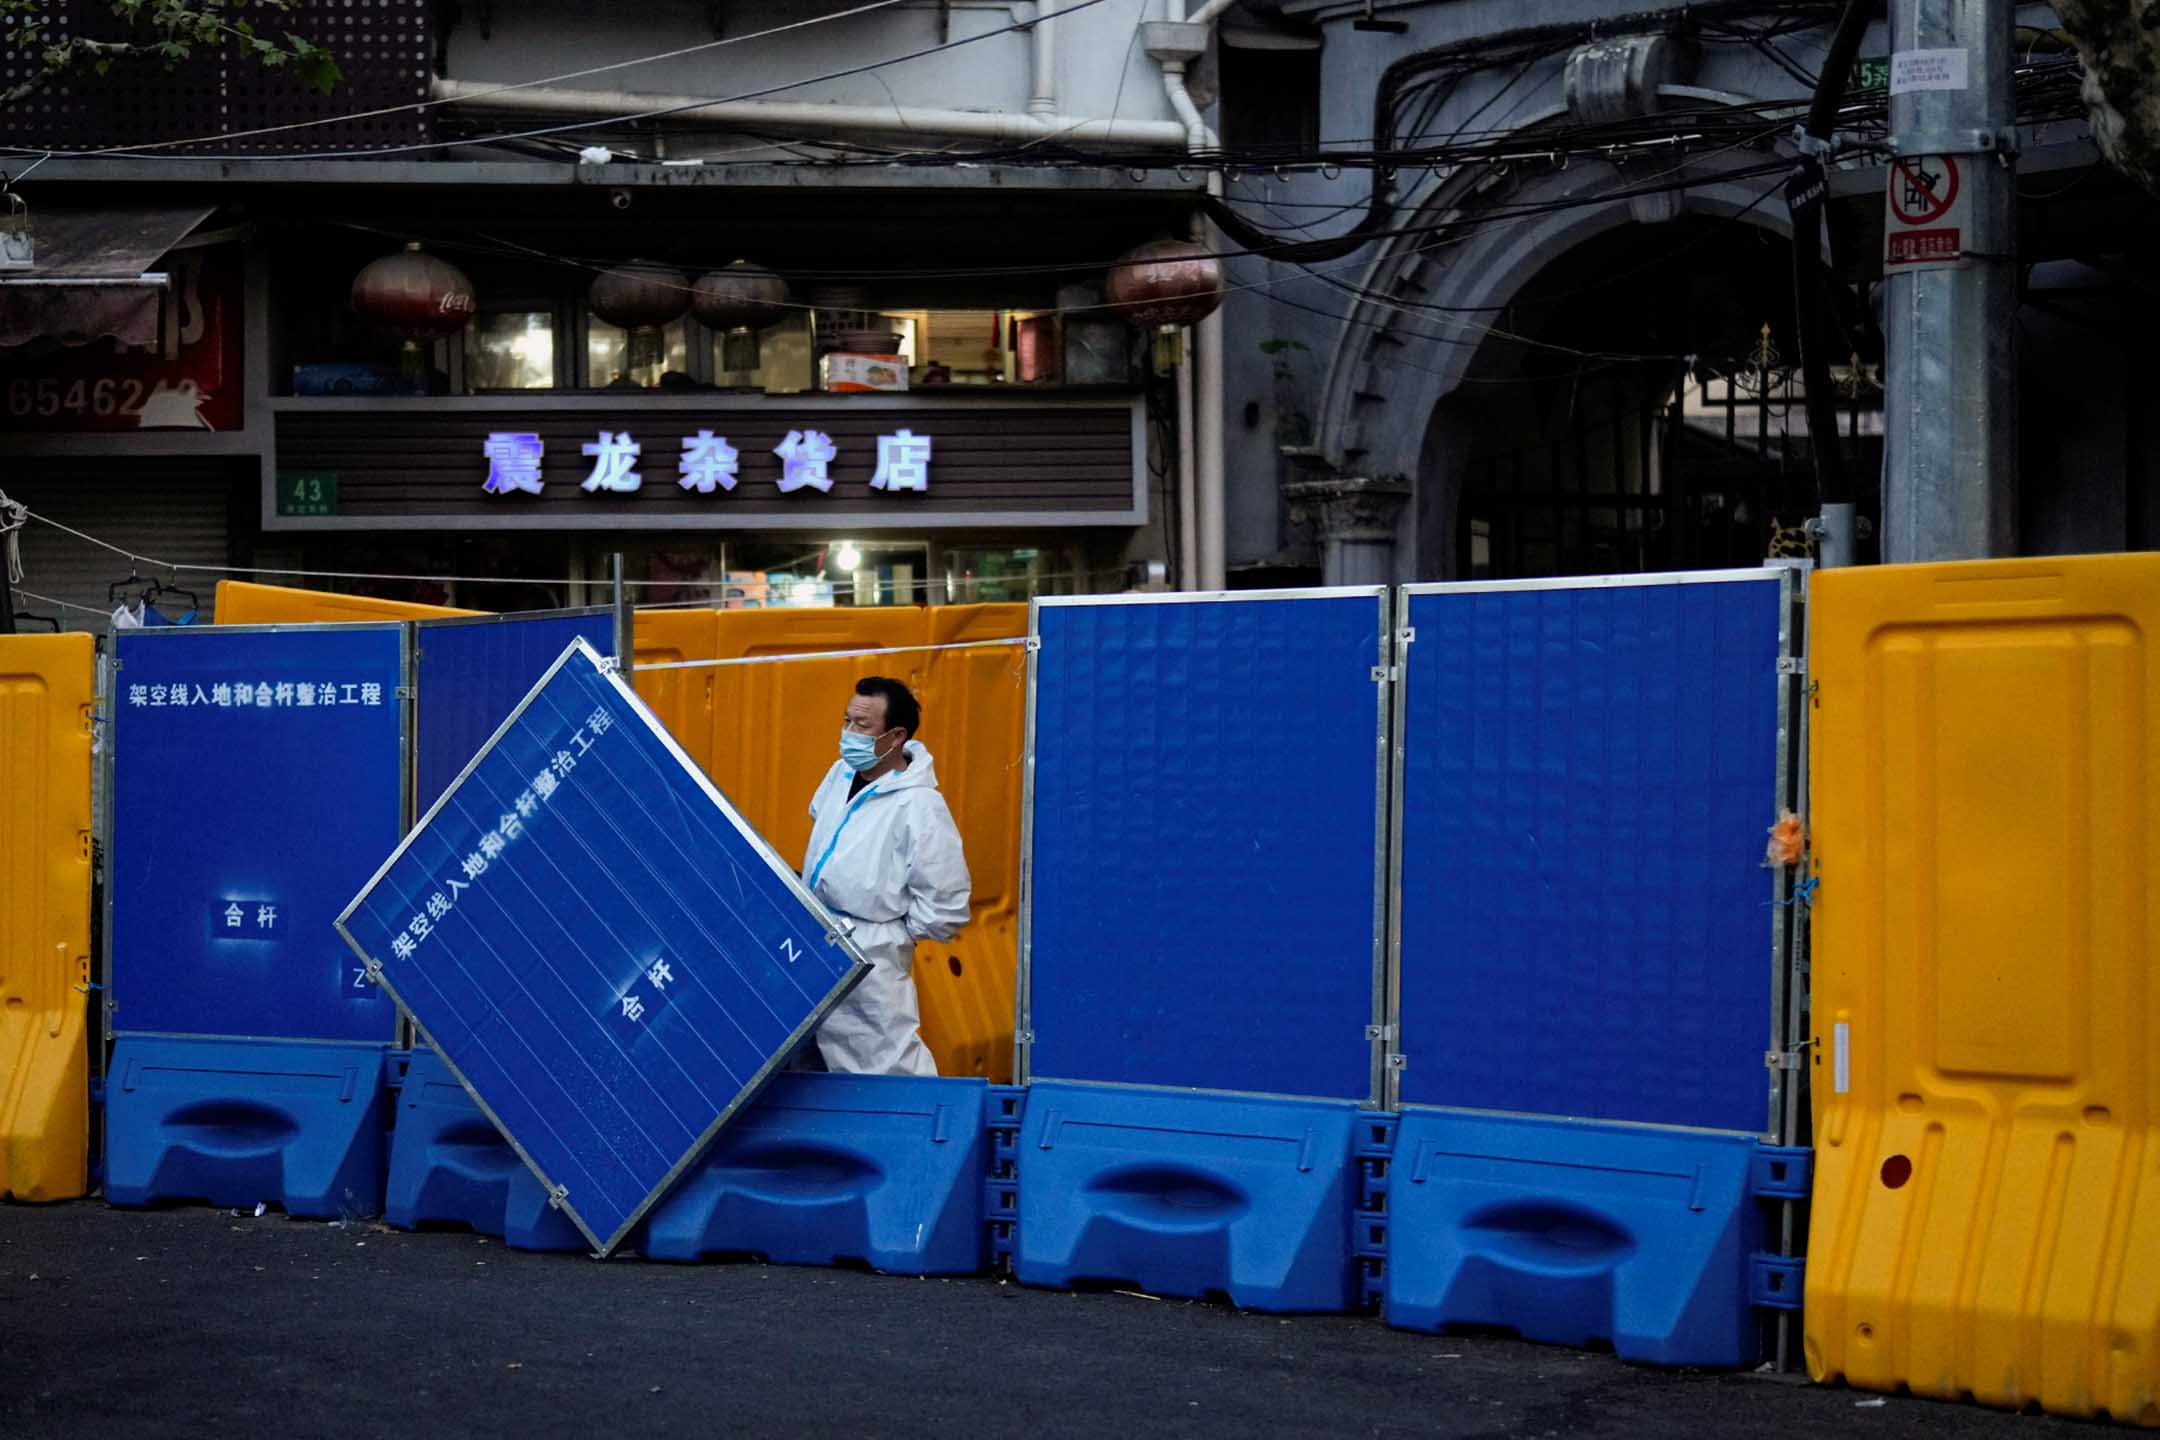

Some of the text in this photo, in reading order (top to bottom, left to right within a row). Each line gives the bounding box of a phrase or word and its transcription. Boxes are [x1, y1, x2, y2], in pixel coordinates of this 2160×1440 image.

[482, 429, 931, 493] 震龙杂货店
[293, 479, 321, 502] 43
[130, 681, 380, 707] 架空线入地和合杆整治工程
[391, 706, 613, 960] 架空线入地和合杆整治工程
[225, 903, 277, 928] 合杆
